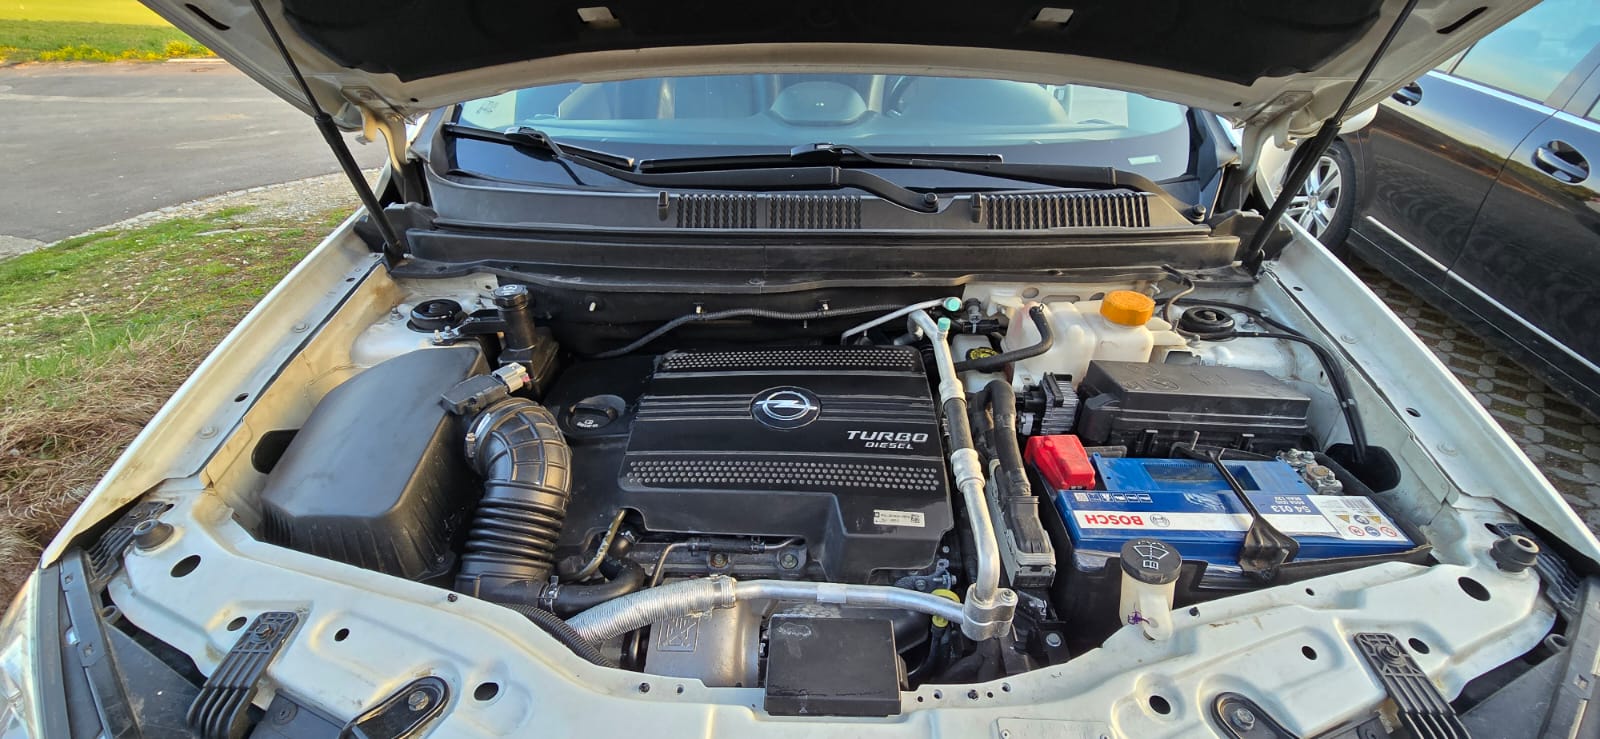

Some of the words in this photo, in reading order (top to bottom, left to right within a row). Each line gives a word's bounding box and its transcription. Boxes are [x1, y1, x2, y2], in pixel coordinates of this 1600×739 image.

[847, 431, 929, 442] TURBO
[865, 441, 914, 450] DIESEL
[1271, 505, 1294, 513] 013
[1294, 505, 1312, 513] S4
[1084, 514, 1145, 526] BOSCH
